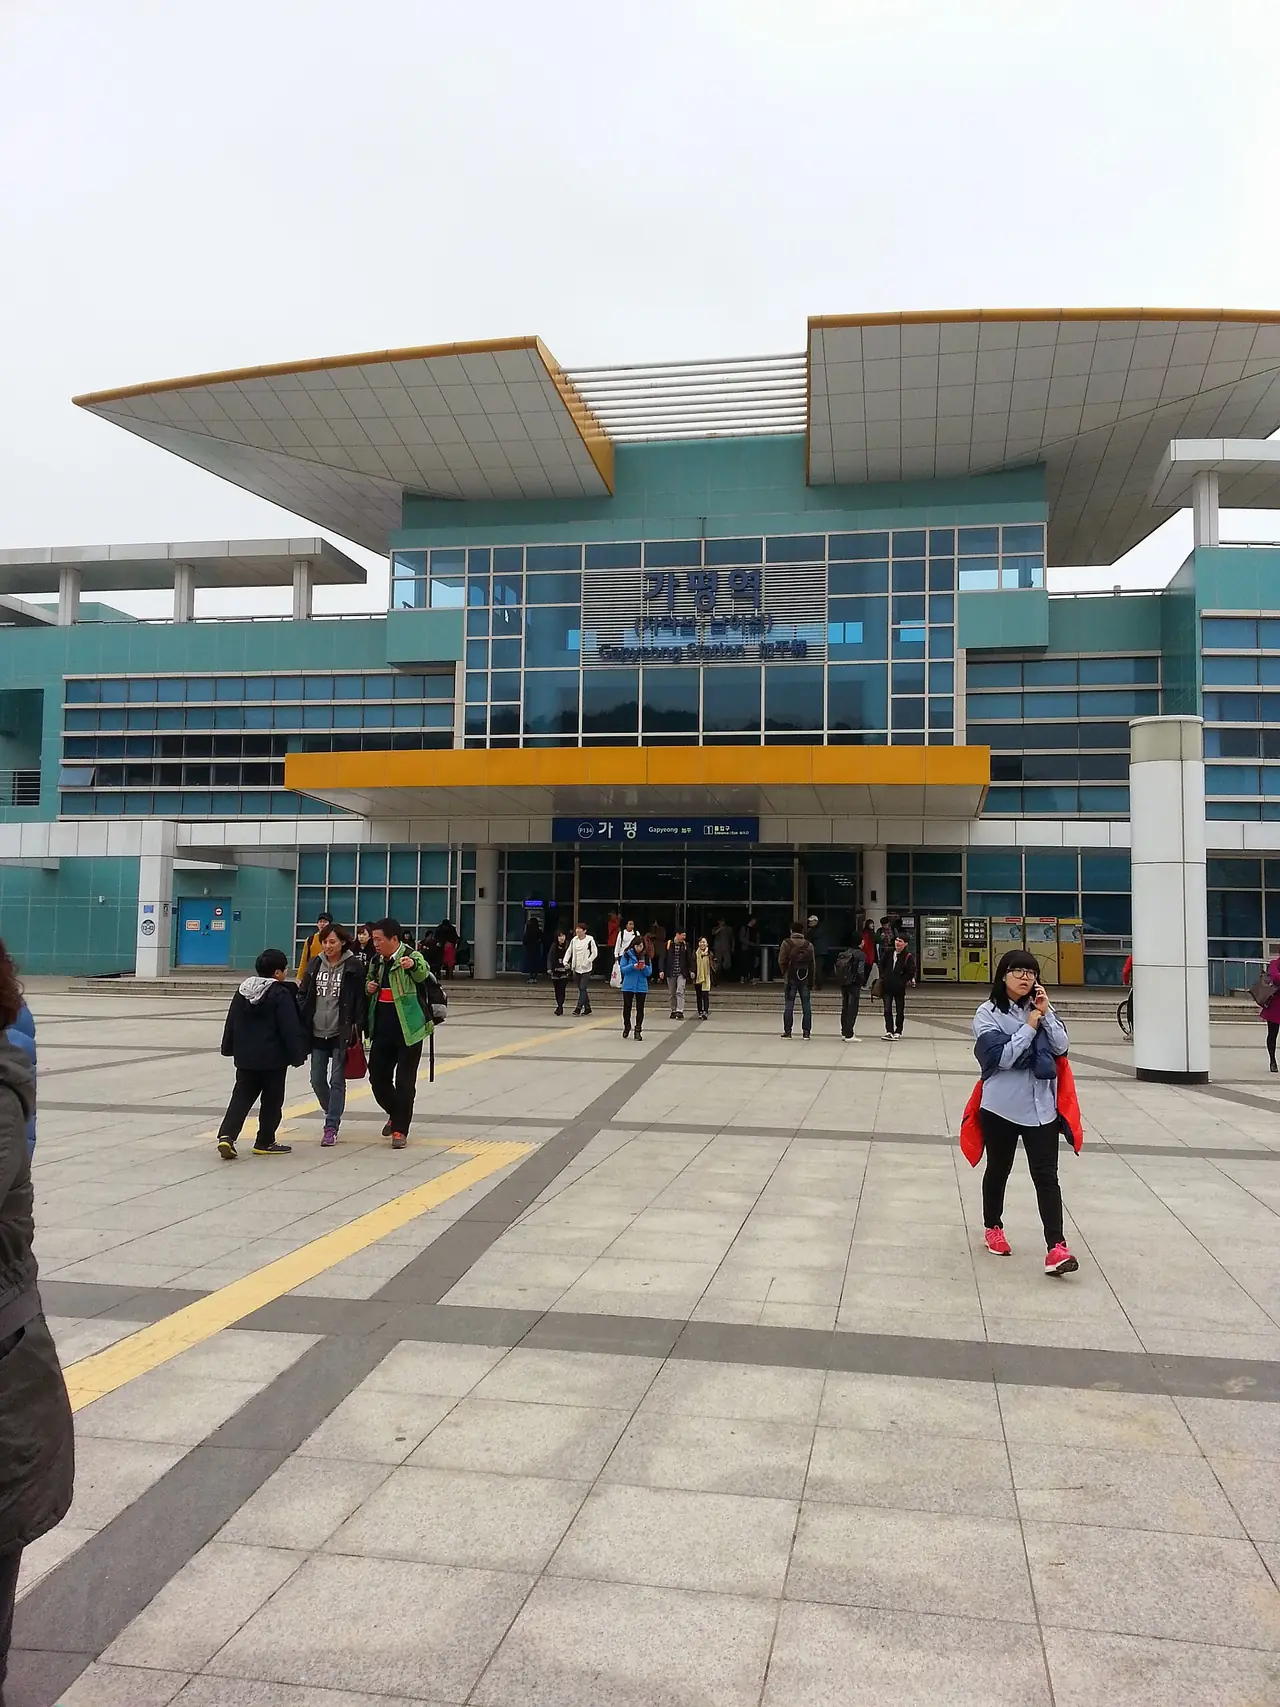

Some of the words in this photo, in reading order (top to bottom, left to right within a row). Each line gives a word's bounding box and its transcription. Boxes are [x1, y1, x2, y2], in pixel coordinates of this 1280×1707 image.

[643, 568, 761, 611] 가평역
[598, 644, 682, 663] Gapyeong
[686, 642, 745, 659] Station
[648, 826, 679, 834] Gapyeong
